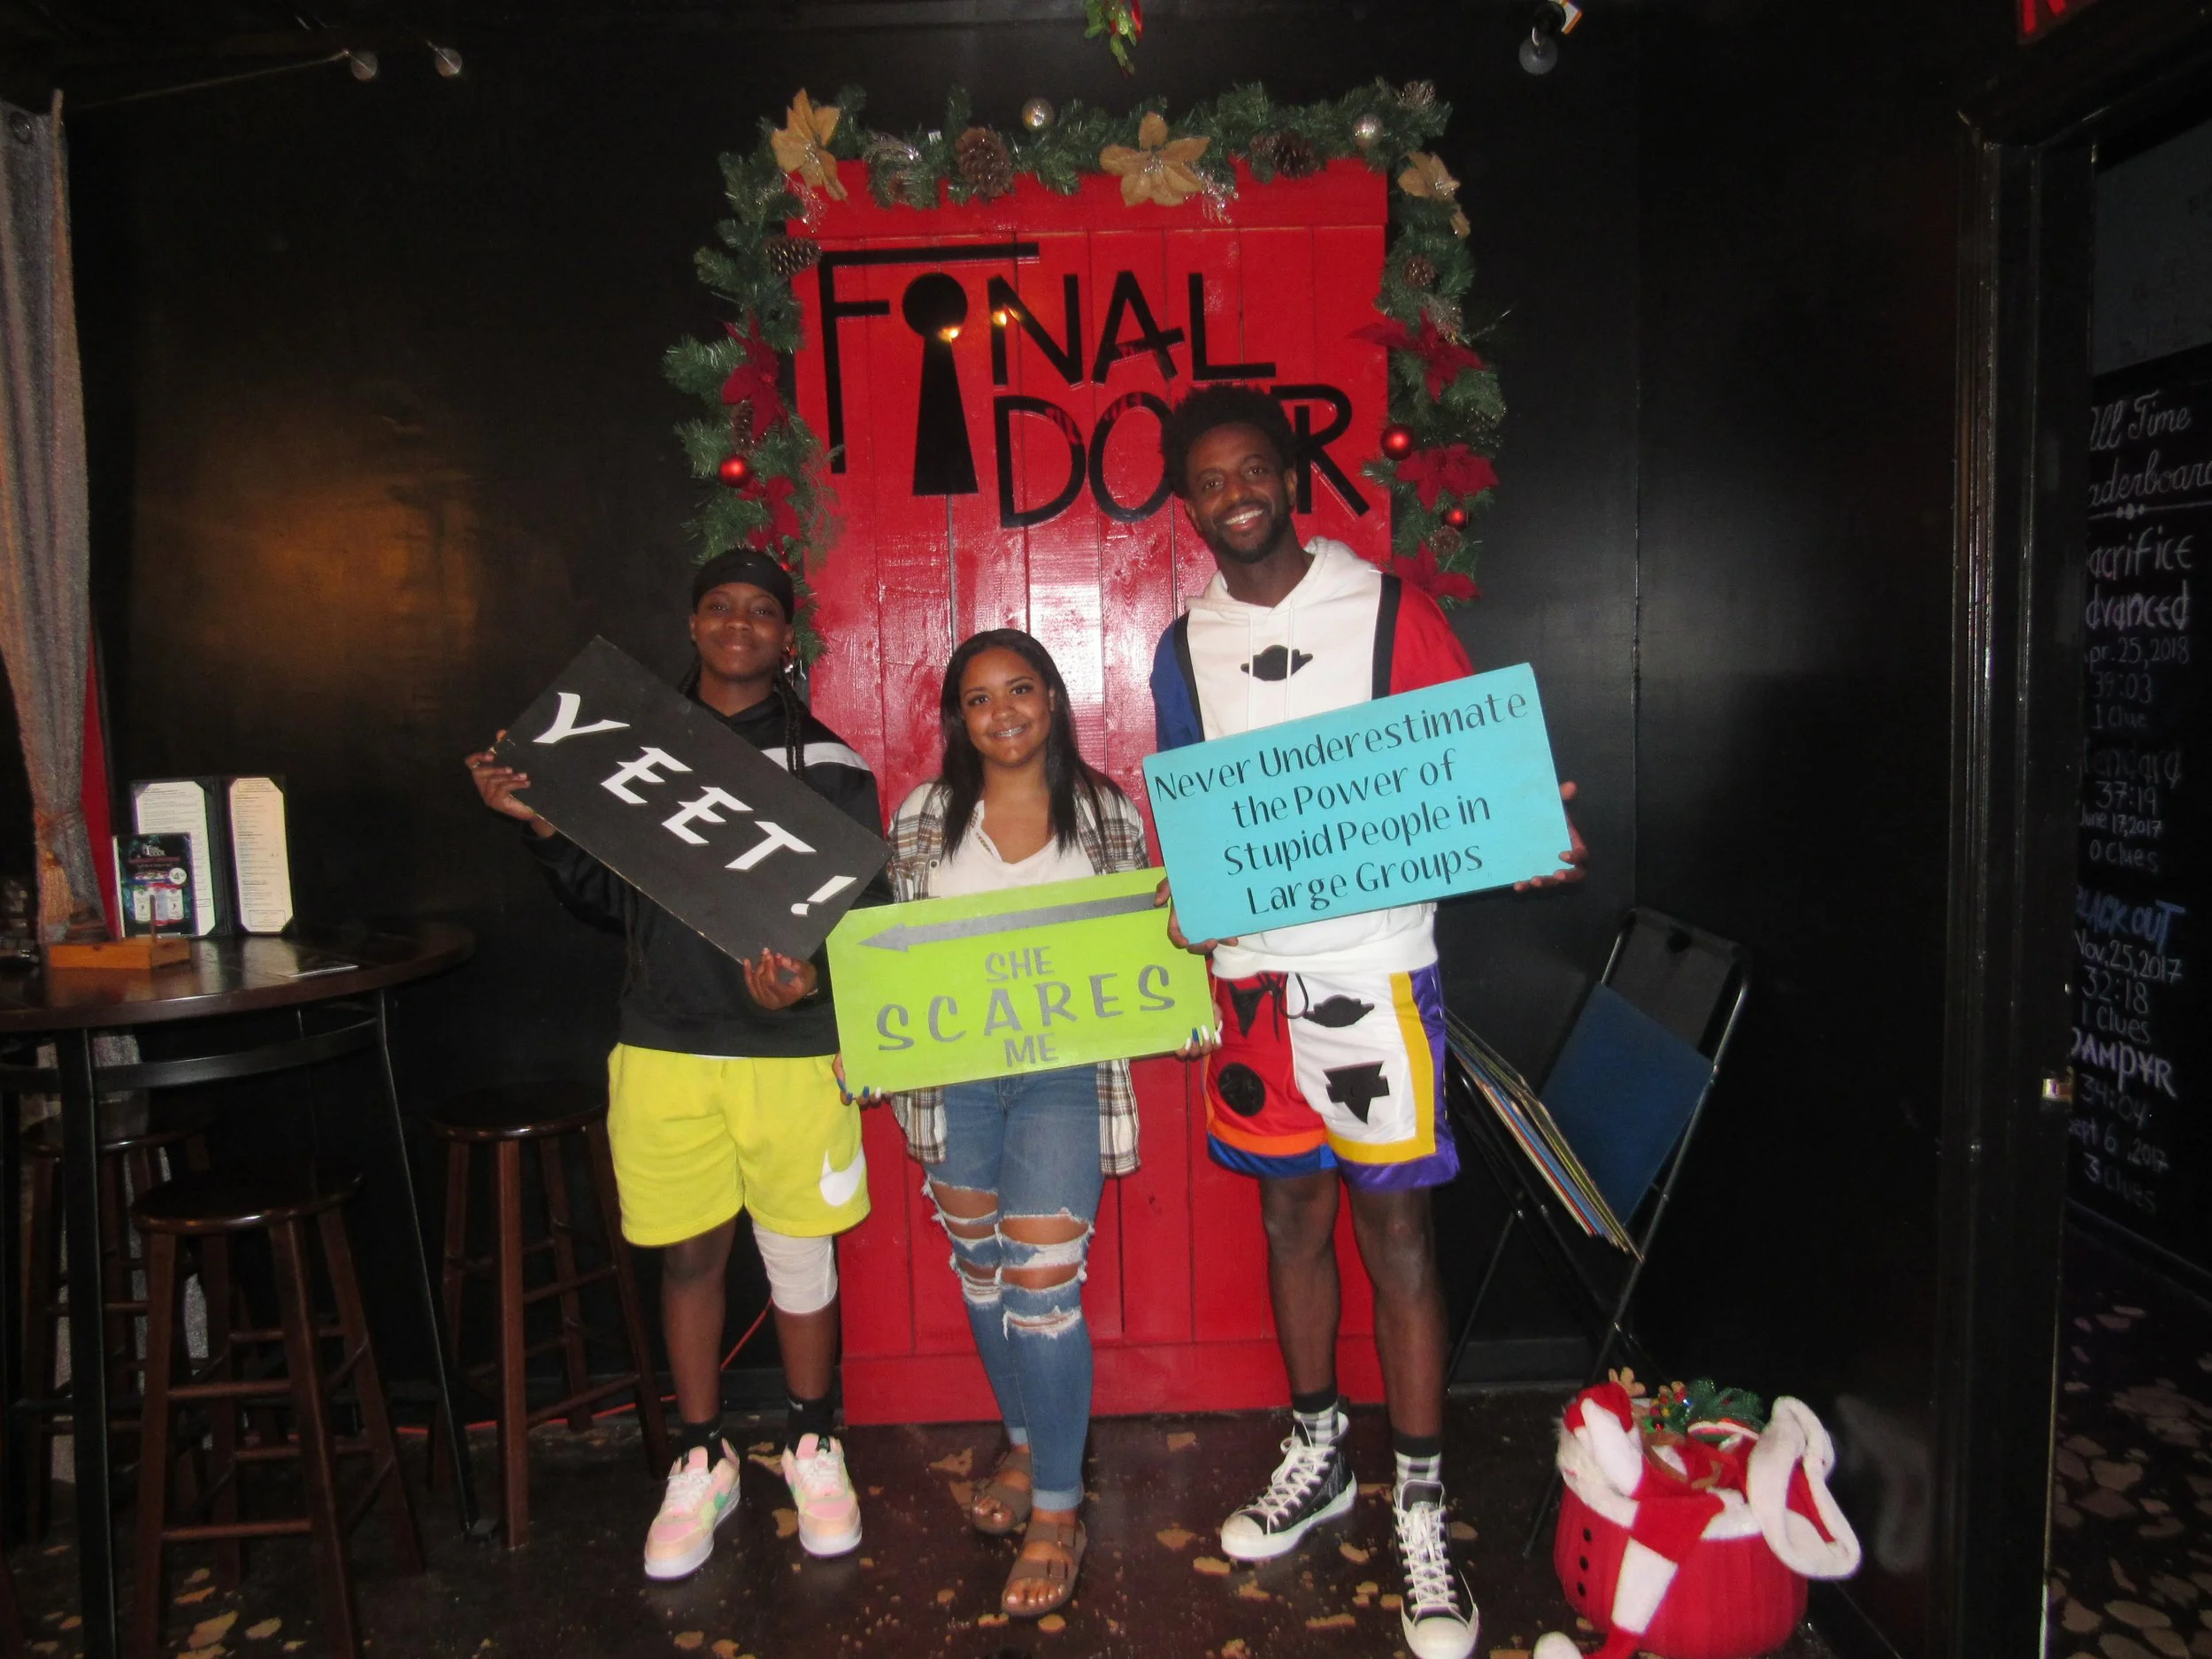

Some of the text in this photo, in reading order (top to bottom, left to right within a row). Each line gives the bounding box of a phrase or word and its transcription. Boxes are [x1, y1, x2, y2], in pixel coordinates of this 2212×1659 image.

[2127, 389, 2192, 440] Time
[993, 384, 1370, 528] DOR
[2088, 524, 2194, 580] acrifice
[2085, 579, 2190, 631] dvanced
[1154, 692, 1527, 802] Never Underestimate
[532, 692, 857, 916] YEET!
[1232, 747, 1456, 829] the Power of
[2094, 780, 2157, 816] 37:19
[1223, 795, 1491, 876] Stupid People in
[2106, 842, 2159, 872] Clues
[1246, 845, 1483, 915] Large Groups
[985, 946, 1055, 983] SHE
[2081, 964, 2149, 1015] 32:18
[876, 964, 1175, 1051] SCARES
[2096, 1006, 2151, 1044] Clues
[1003, 1033, 1060, 1068] ME
